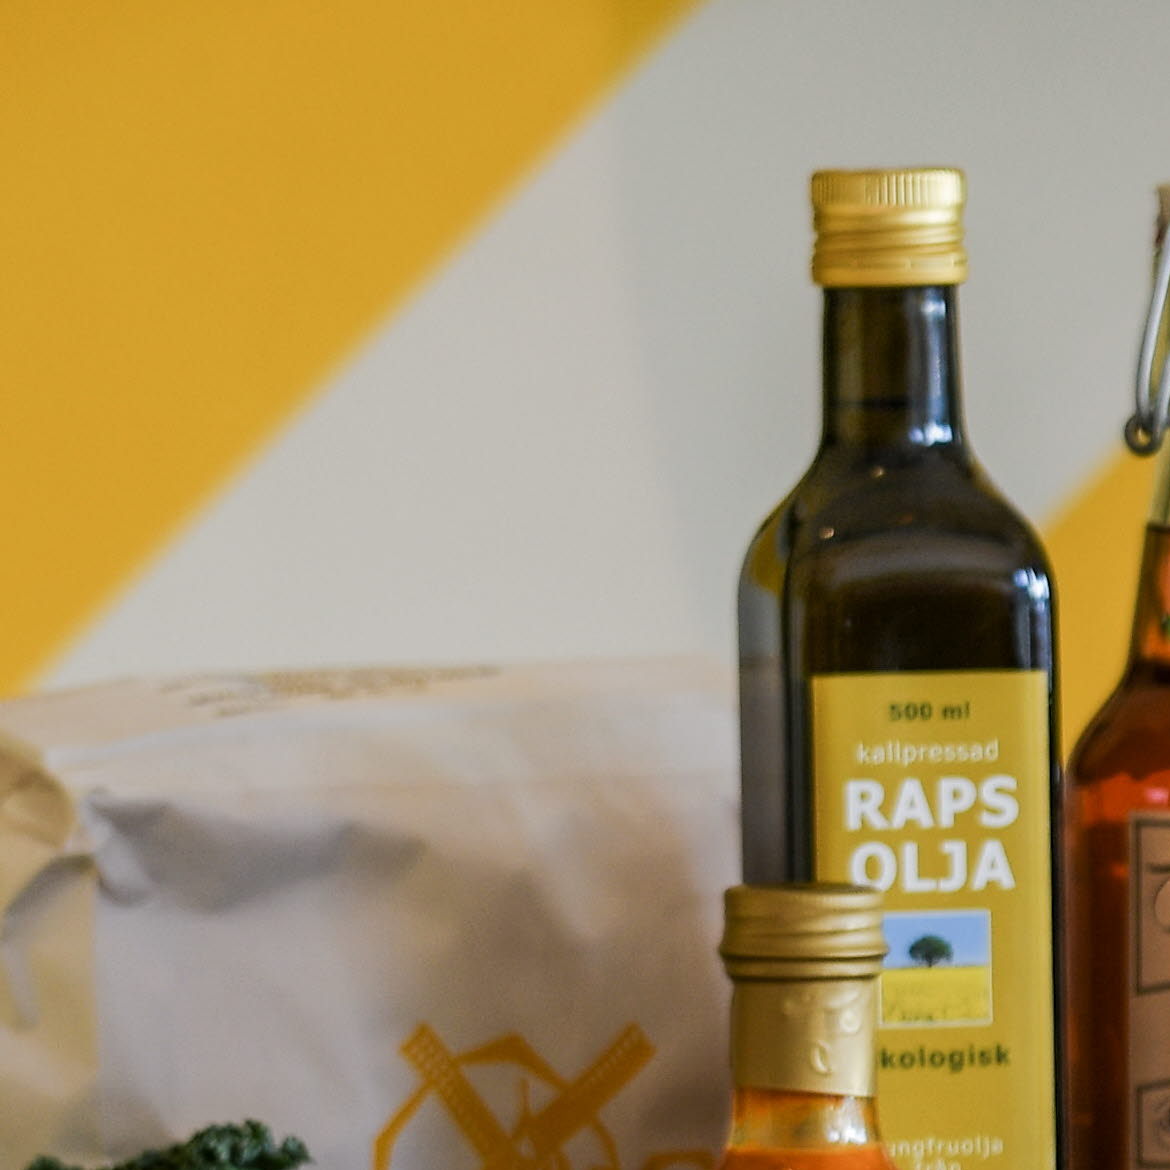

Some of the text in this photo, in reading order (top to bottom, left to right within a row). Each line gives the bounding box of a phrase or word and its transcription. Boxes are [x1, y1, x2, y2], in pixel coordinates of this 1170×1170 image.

[889, 702, 971, 722] 500 ml
[857, 738, 999, 767] kallpressad
[845, 775, 1020, 831] RAPS
[850, 839, 1016, 893] OLJA
[880, 1045, 1010, 1073] kologisk
